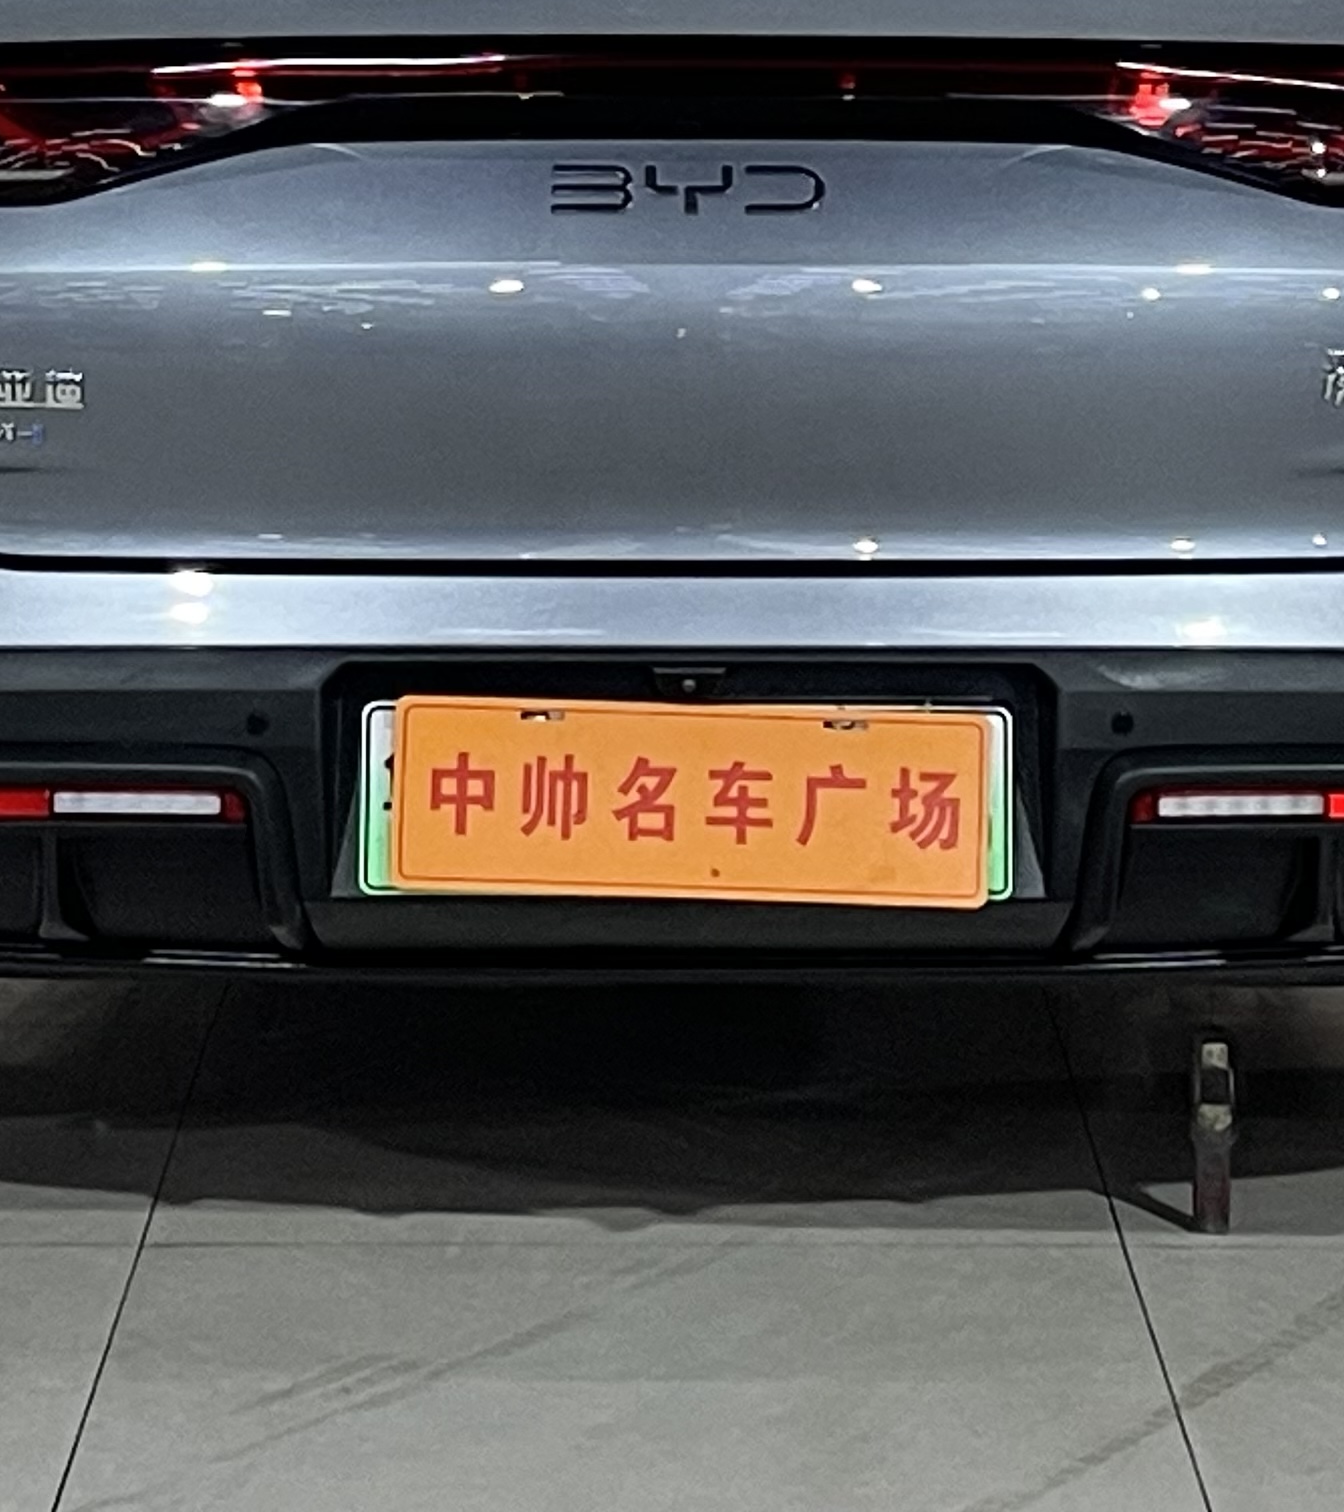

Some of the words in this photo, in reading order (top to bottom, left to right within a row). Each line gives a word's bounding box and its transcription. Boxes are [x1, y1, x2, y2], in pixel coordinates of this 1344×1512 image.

[551, 164, 826, 215] BYD
[428, 750, 962, 851] 中帅名车广场
